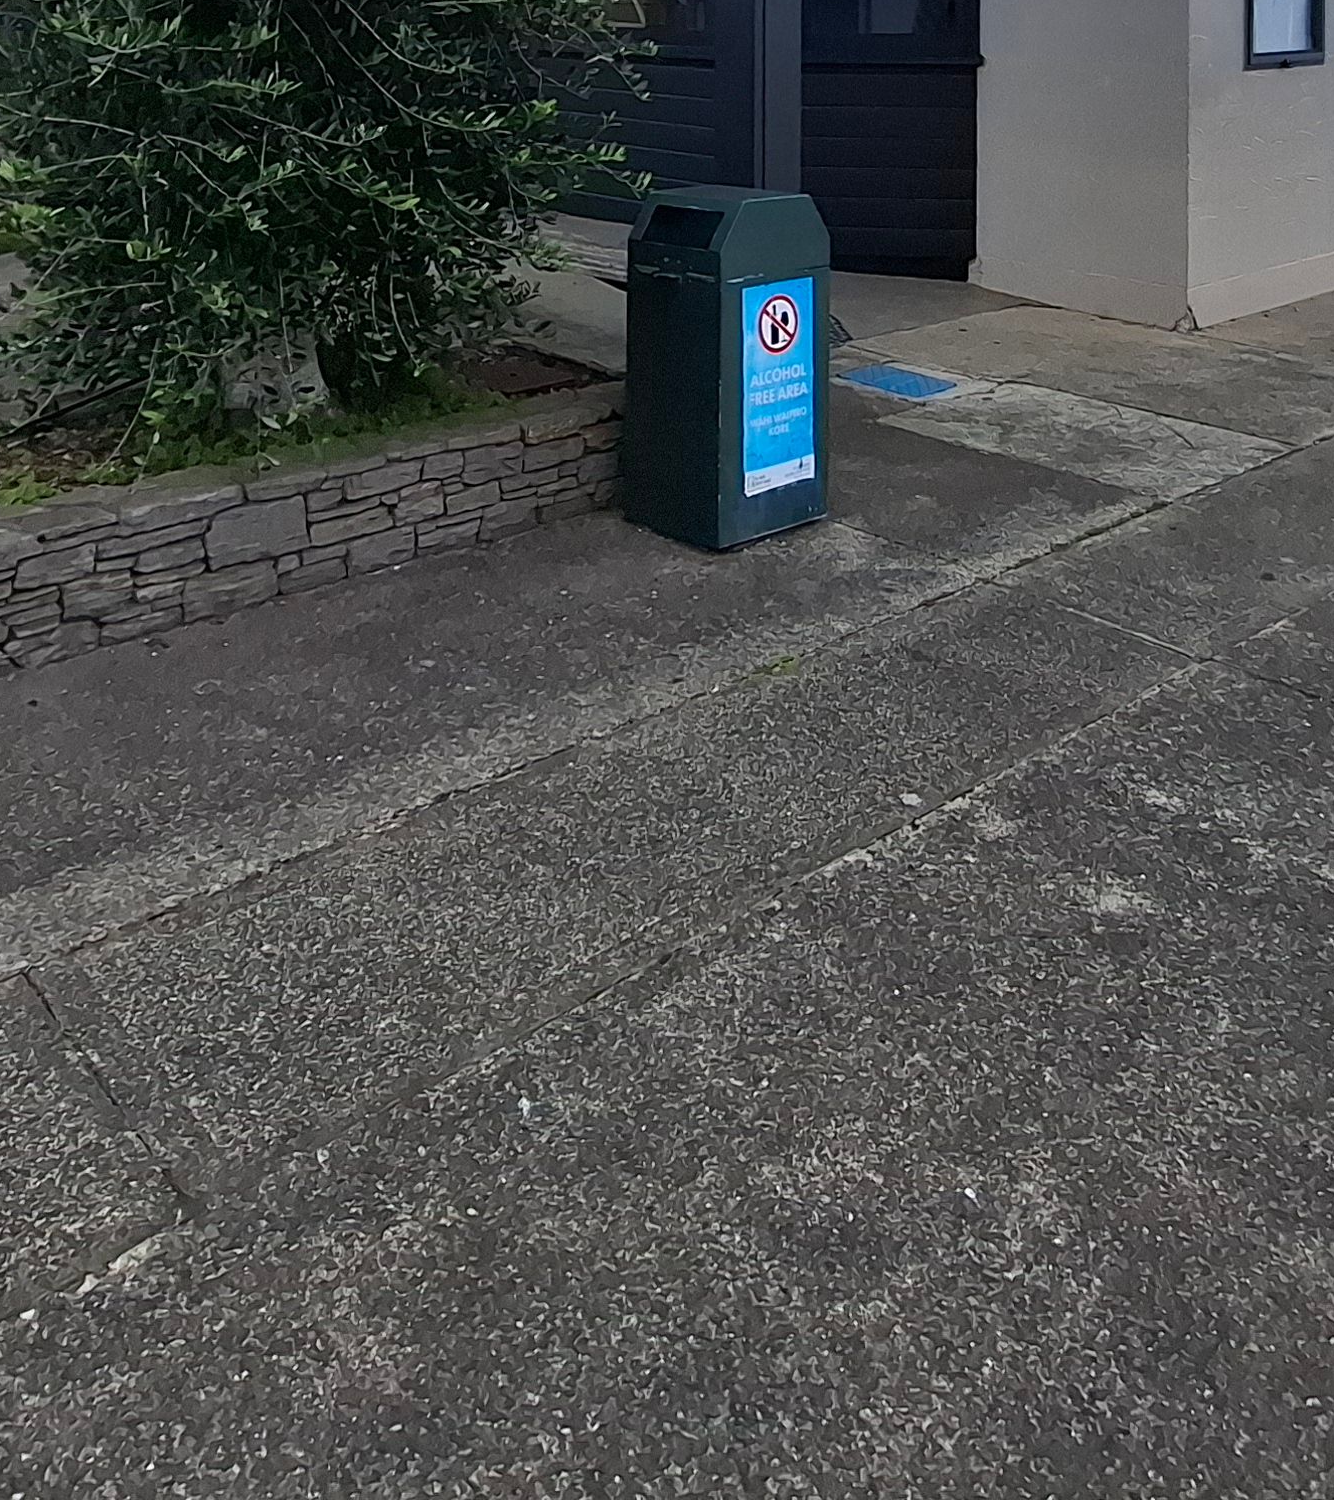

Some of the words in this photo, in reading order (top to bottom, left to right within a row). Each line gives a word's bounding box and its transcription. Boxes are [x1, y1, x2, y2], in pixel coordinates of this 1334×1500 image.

[750, 363, 807, 388] ALCOHOL
[749, 390, 776, 406] FREE
[777, 381, 808, 401] AREA
